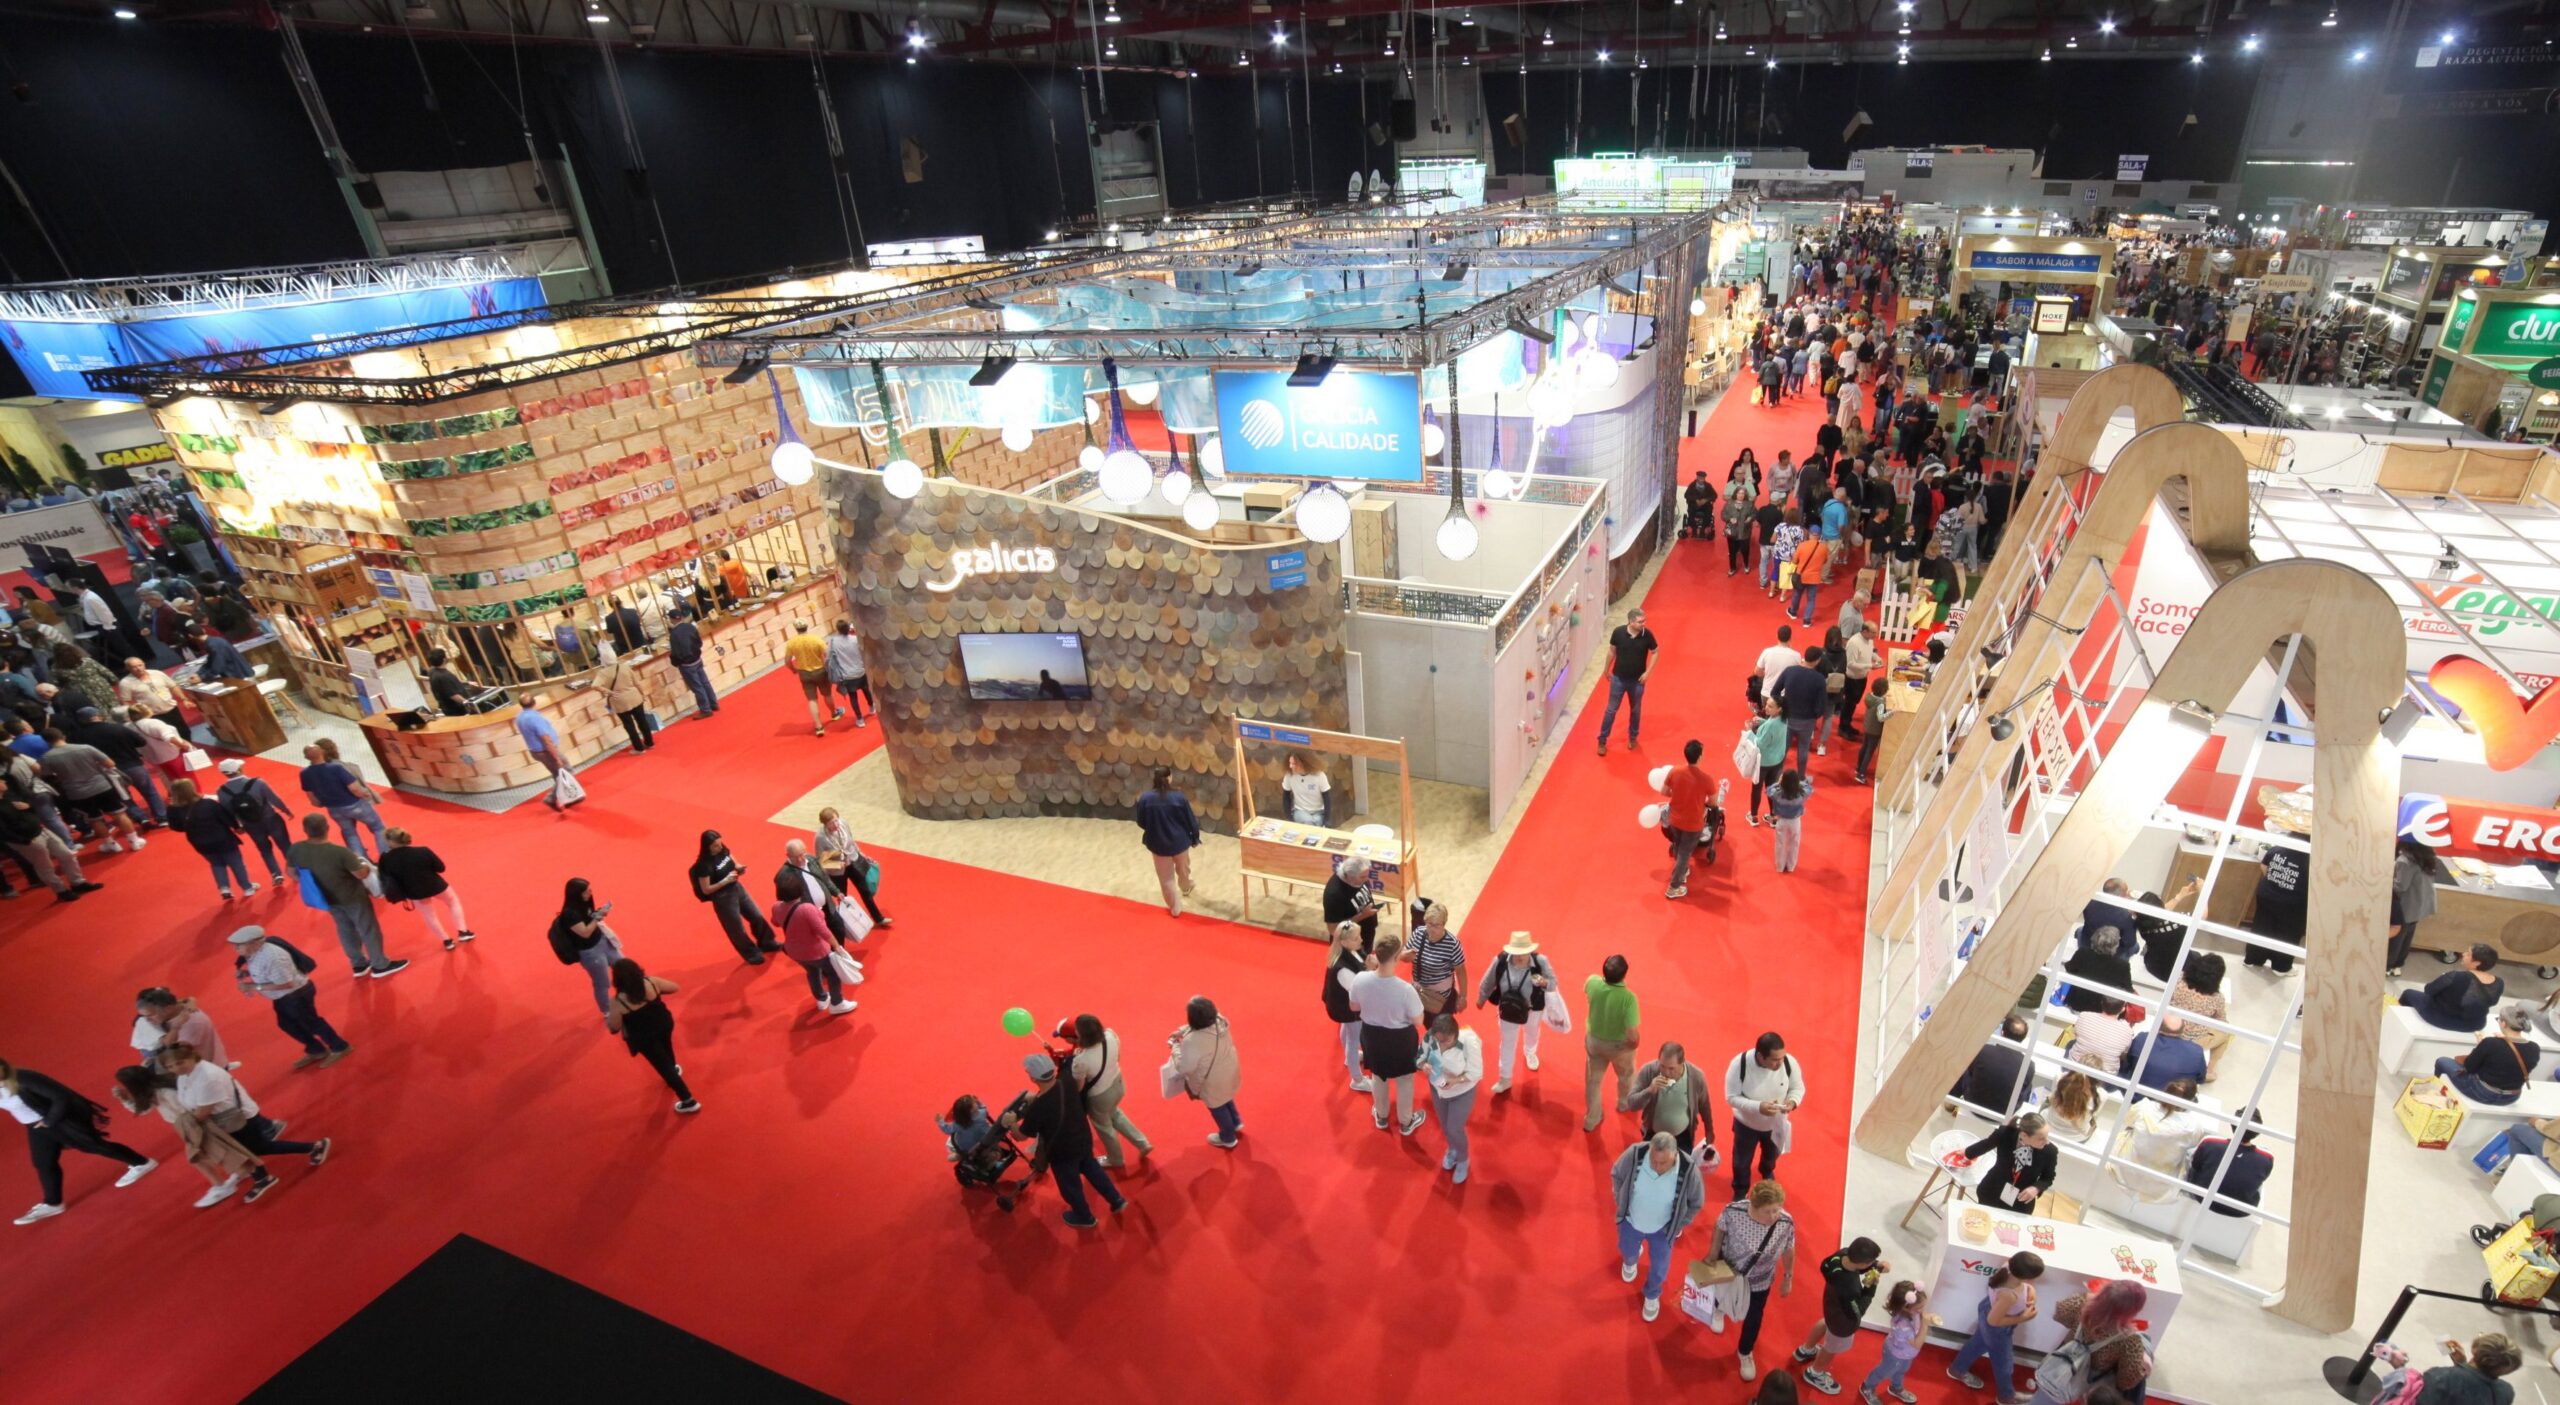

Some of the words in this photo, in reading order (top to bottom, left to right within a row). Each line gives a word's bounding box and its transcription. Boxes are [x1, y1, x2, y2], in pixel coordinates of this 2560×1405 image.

[1906, 159, 1933, 167] SALA-2
[2118, 161, 2146, 170] SALA-1
[1996, 257, 2026, 265] SABOR
[2036, 256, 2075, 267] MÁLAGA
[1302, 431, 1400, 452] CALIDADE
[103, 443, 174, 466] GADIS
[0, 525, 86, 550] ostibilidade
[925, 539, 1058, 593] galicia
[2133, 615, 2186, 636] face
[2421, 621, 2469, 635] EROSI
[2517, 675, 2554, 689] ERO
[2473, 815, 2560, 855] ERO
